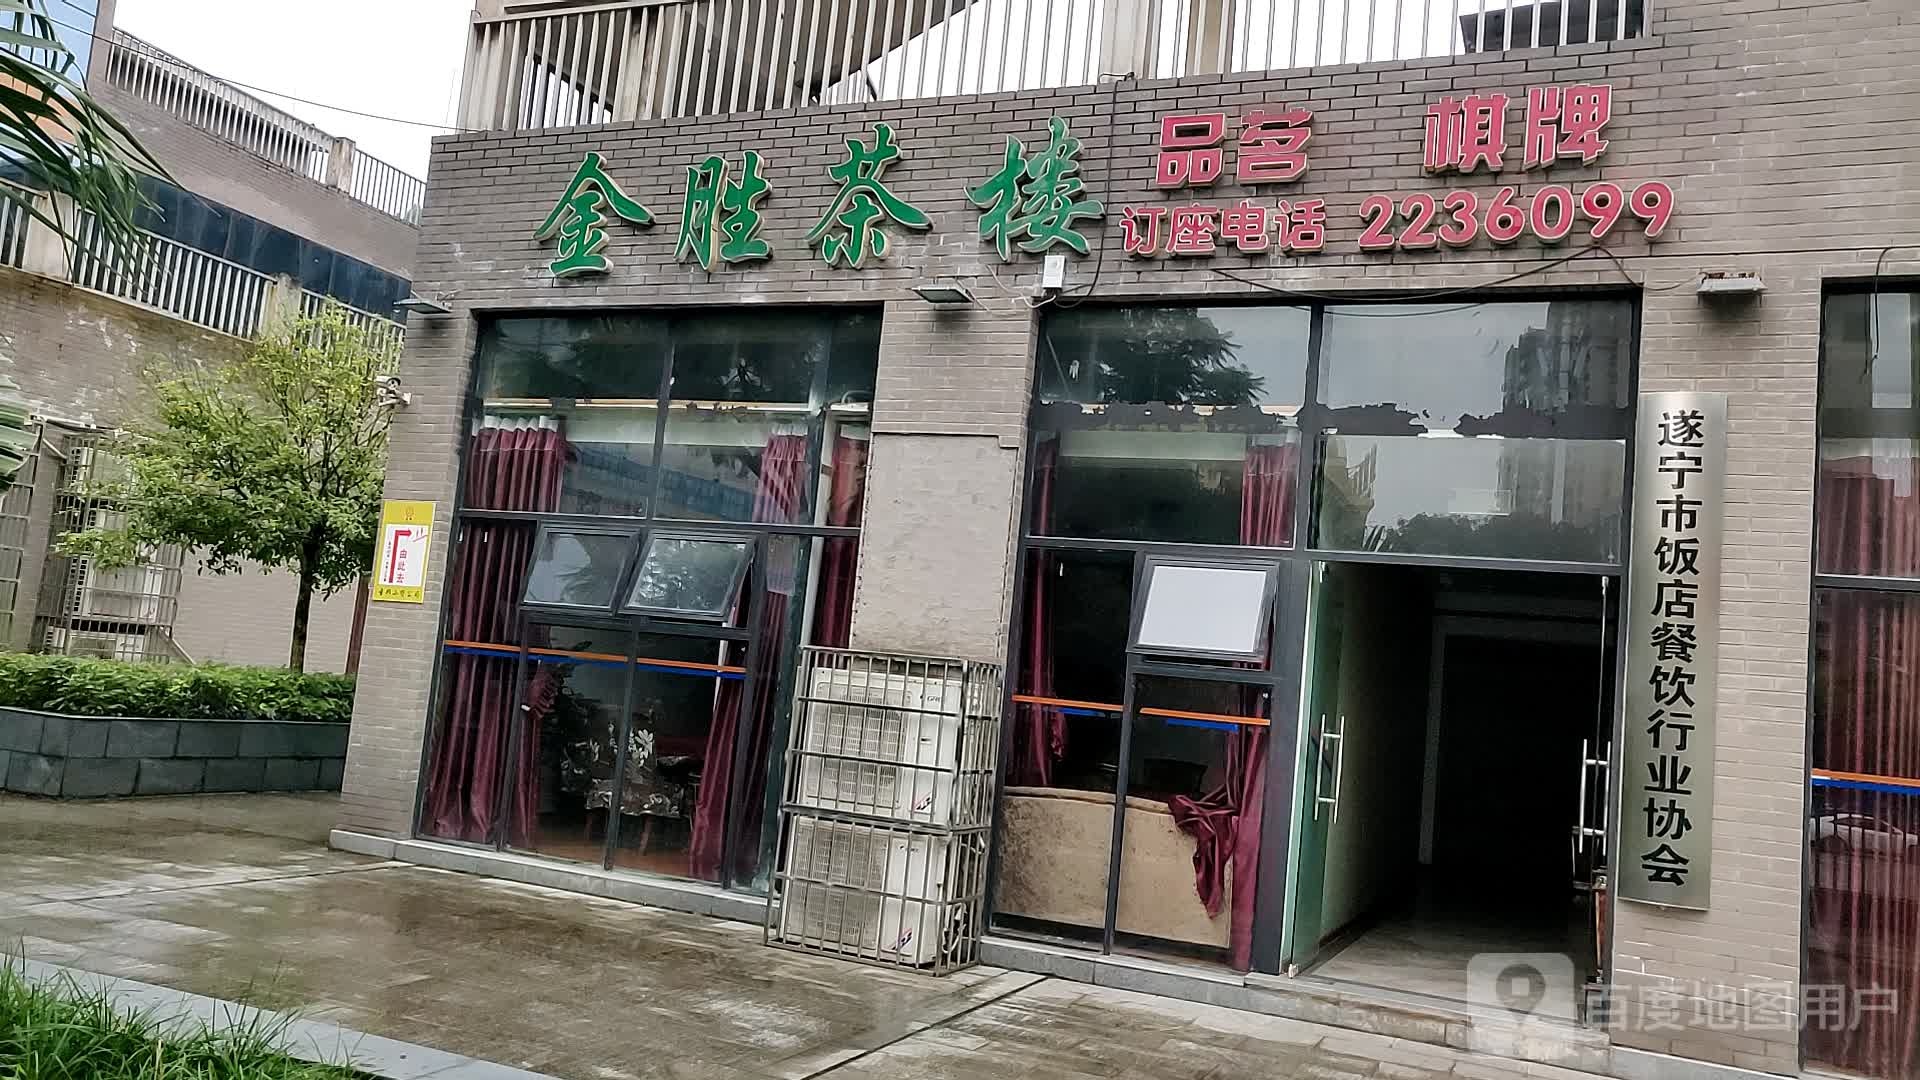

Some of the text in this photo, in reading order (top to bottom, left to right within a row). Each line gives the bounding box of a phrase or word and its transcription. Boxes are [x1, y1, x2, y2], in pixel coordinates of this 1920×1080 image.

[1423, 83, 1613, 173] 棋牌
[533, 115, 1105, 278] 金胜茶楼
[1119, 181, 1675, 257] 订座电话 2236099
[1641, 409, 1704, 887] 遂宁市饭店餐饮行业协会
